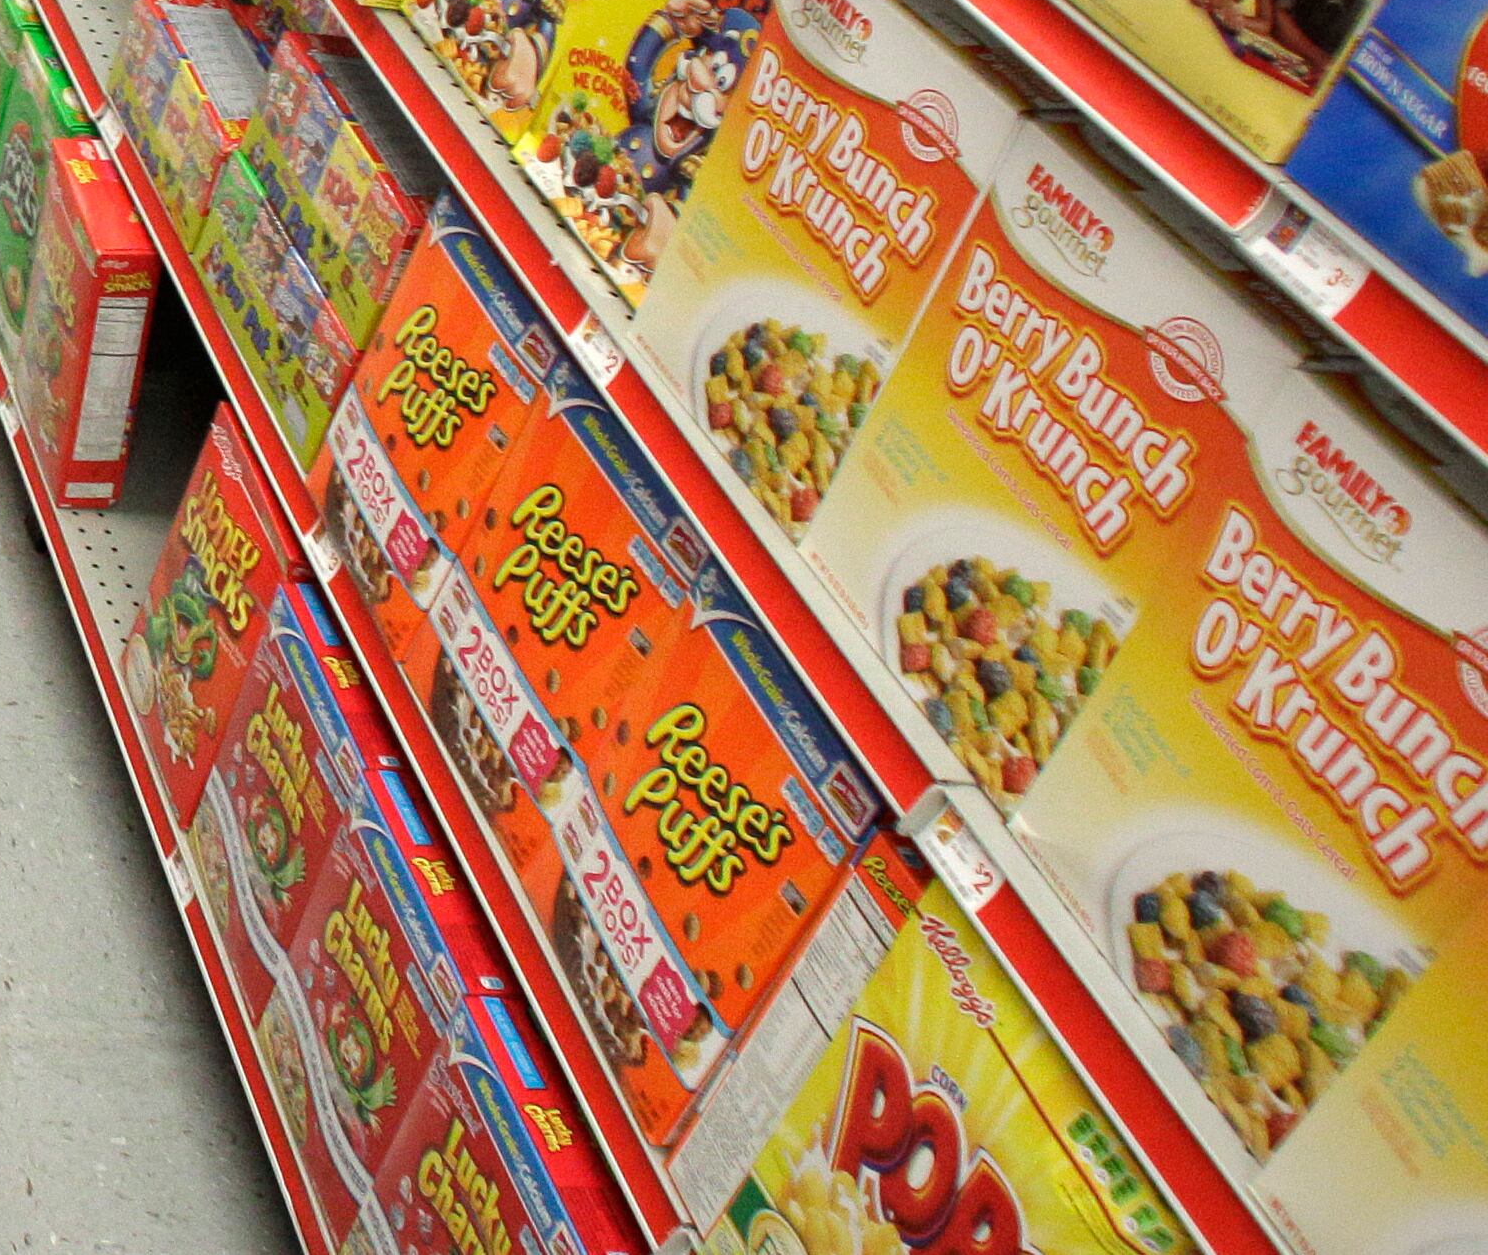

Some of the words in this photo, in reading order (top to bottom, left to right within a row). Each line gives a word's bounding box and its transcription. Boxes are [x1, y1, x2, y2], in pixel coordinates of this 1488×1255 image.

[747, 48, 829, 145] Berry
[822, 114, 933, 254] Bunch
[1399, 86, 1448, 139] SUGAR
[378, 362, 462, 446] Puffs
[396, 305, 495, 414] Reese's
[957, 245, 1073, 375] Berry
[1055, 333, 1193, 509] Bunch
[347, 439, 366, 477] 2
[363, 452, 394, 515] BOX
[494, 543, 597, 646] Puffs
[512, 486, 638, 612] Reese's
[458, 627, 482, 669] 2
[481, 647, 519, 715] BOX
[247, 714, 304, 834] Charms
[263, 682, 312, 791] Lucky
[584, 851, 610, 898] 2
[974, 865, 995, 895] $2
[345, 879, 401, 1008] Lucky
[922, 916, 994, 1030] Kellogg's
[933, 1065, 969, 1111] CORN
